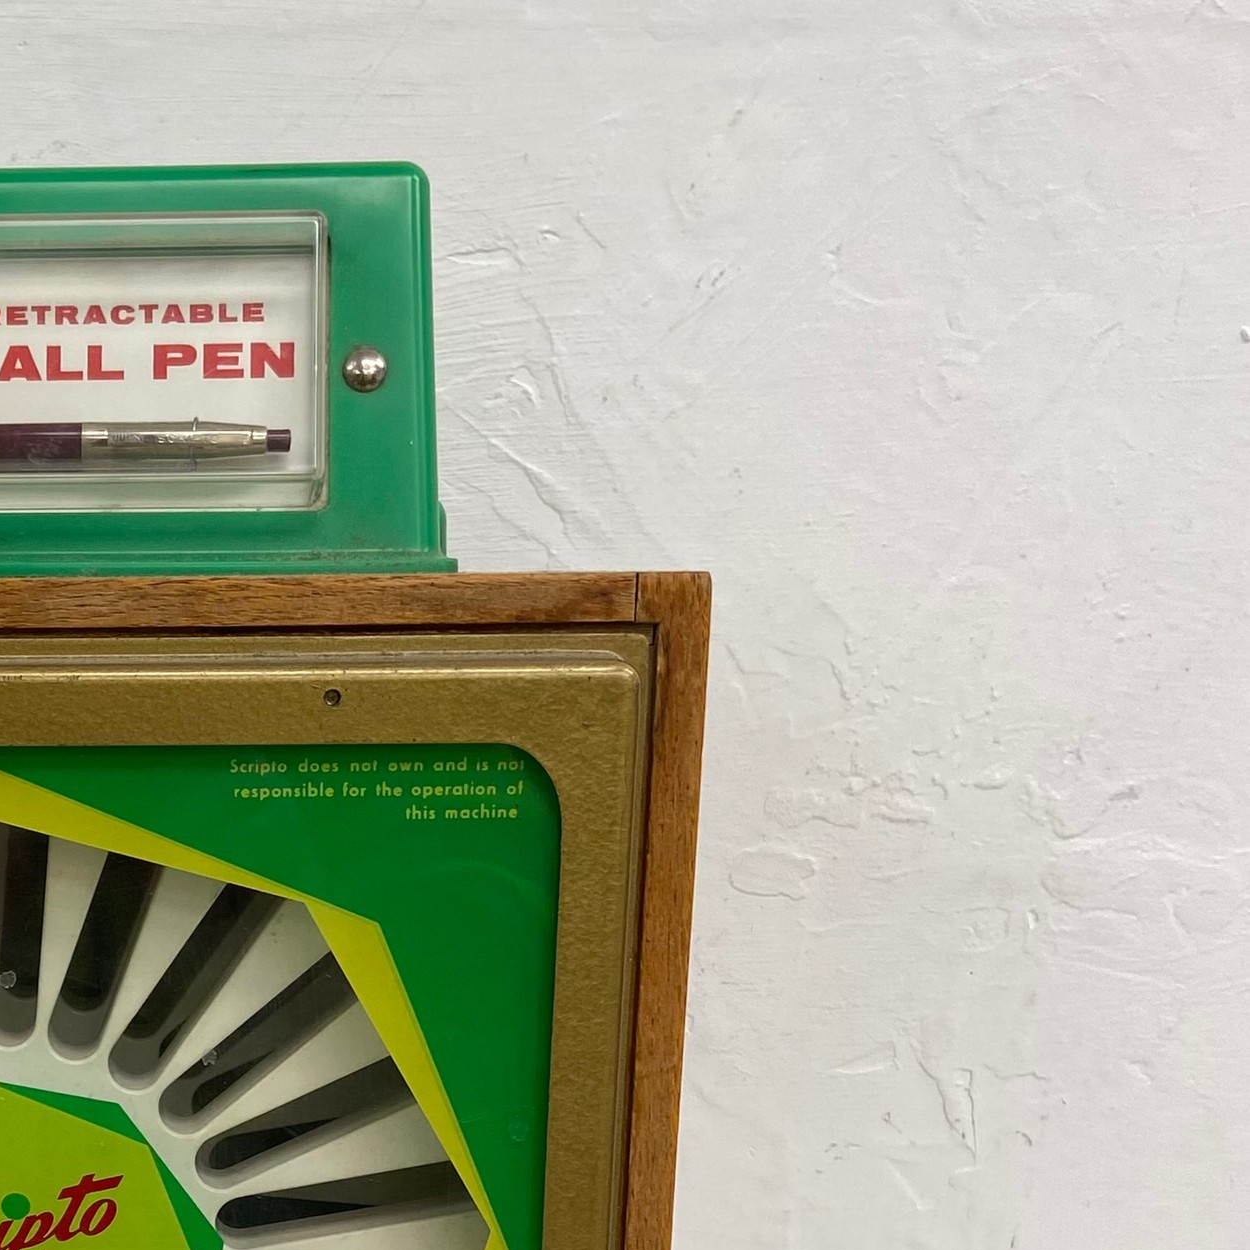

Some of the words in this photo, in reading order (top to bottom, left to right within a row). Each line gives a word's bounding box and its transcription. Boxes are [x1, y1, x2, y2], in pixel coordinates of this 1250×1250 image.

[152, 342, 294, 379] PEN
[230, 760, 287, 775] Scripto
[298, 759, 338, 772] does
[350, 760, 377, 771] not
[388, 761, 424, 771] own
[433, 757, 467, 771] and
[476, 758, 488, 771] is
[234, 783, 334, 800] responsible
[343, 782, 366, 797] for
[376, 782, 402, 797] the
[411, 782, 496, 798] operation
[507, 781, 523, 795] of
[406, 805, 435, 820] this
[445, 804, 517, 819] machine
